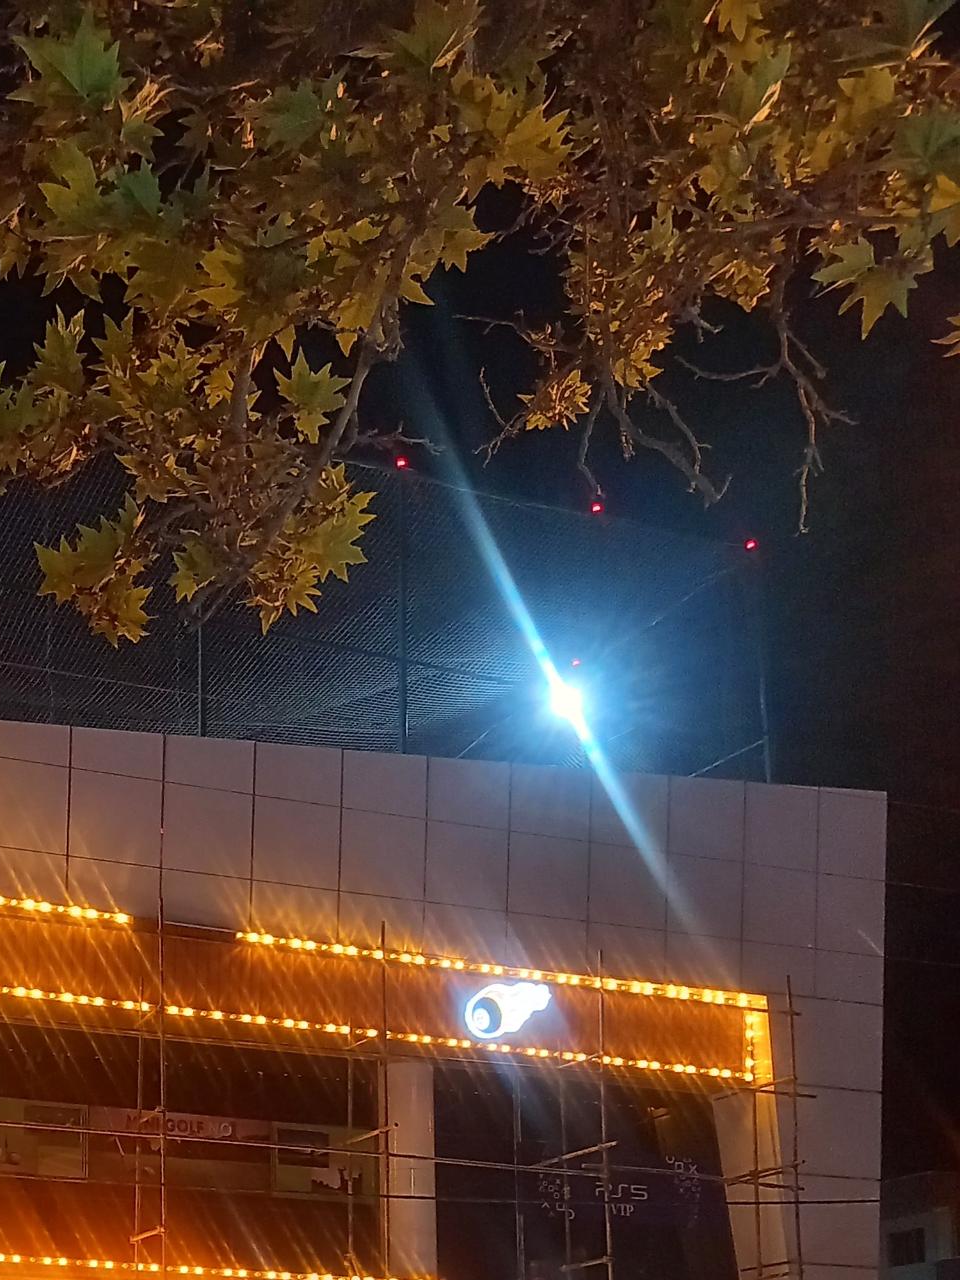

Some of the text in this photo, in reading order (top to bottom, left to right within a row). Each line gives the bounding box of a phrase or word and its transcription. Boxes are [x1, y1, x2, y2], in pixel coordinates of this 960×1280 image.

[126, 1114, 160, 1133] MNI
[166, 1117, 205, 1135] GOLF
[595, 1182, 648, 1201] PS5
[611, 1203, 635, 1217] VIP
